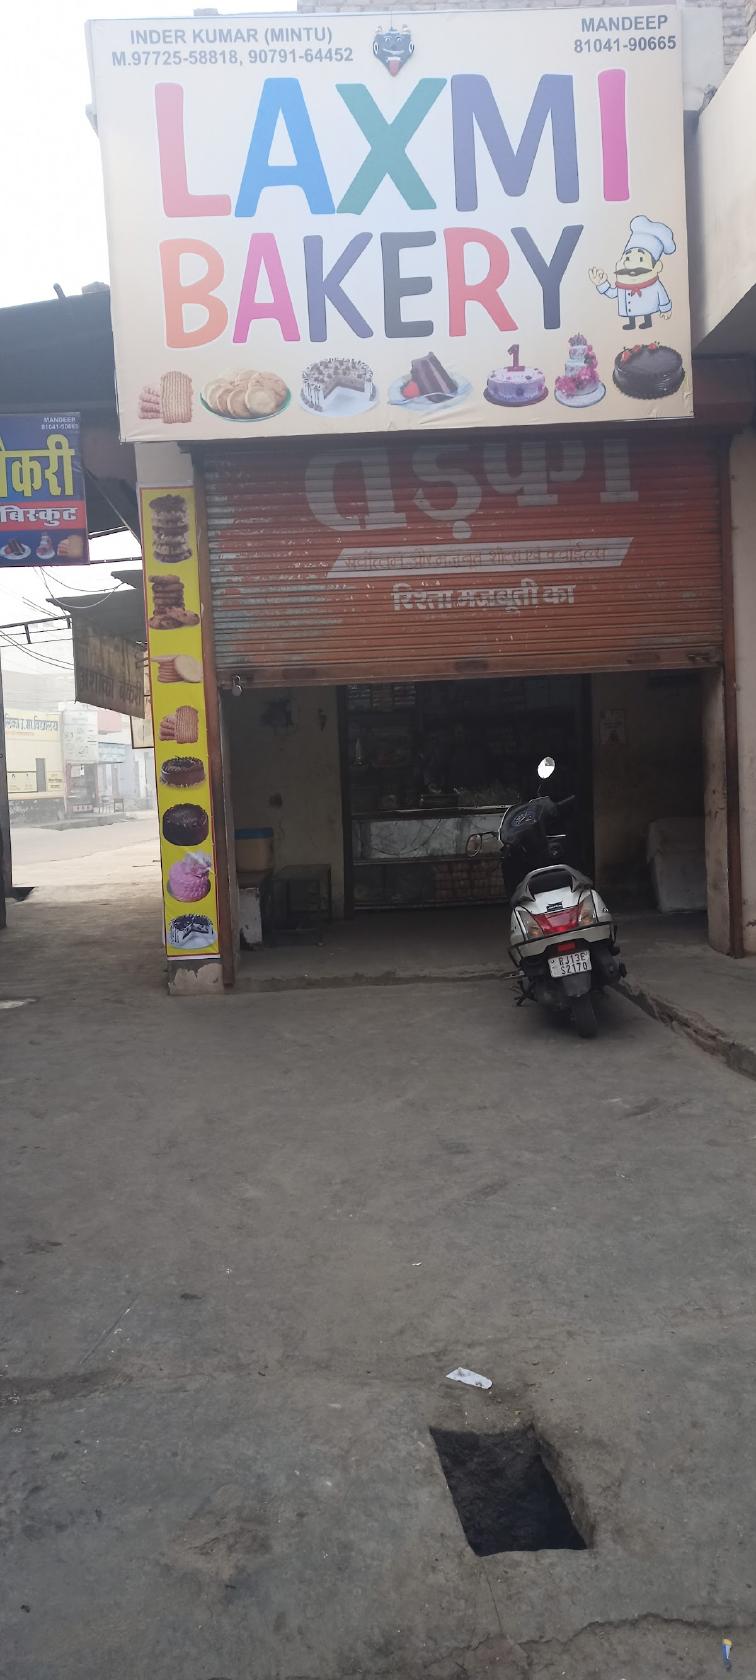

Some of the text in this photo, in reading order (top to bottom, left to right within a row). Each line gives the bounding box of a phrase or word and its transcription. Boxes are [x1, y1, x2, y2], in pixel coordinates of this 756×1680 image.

[581, 15, 669, 32] MANDEEP
[130, 27, 333, 46] INDER KUMAR (MINTU)
[574, 35, 677, 53] 81041-90665
[111, 47, 354, 66] M.97725-58818, 90791-64452
[154, 68, 630, 218] LAXMI
[158, 224, 584, 349] BAKERY
[560, 961, 588, 975] S2170
